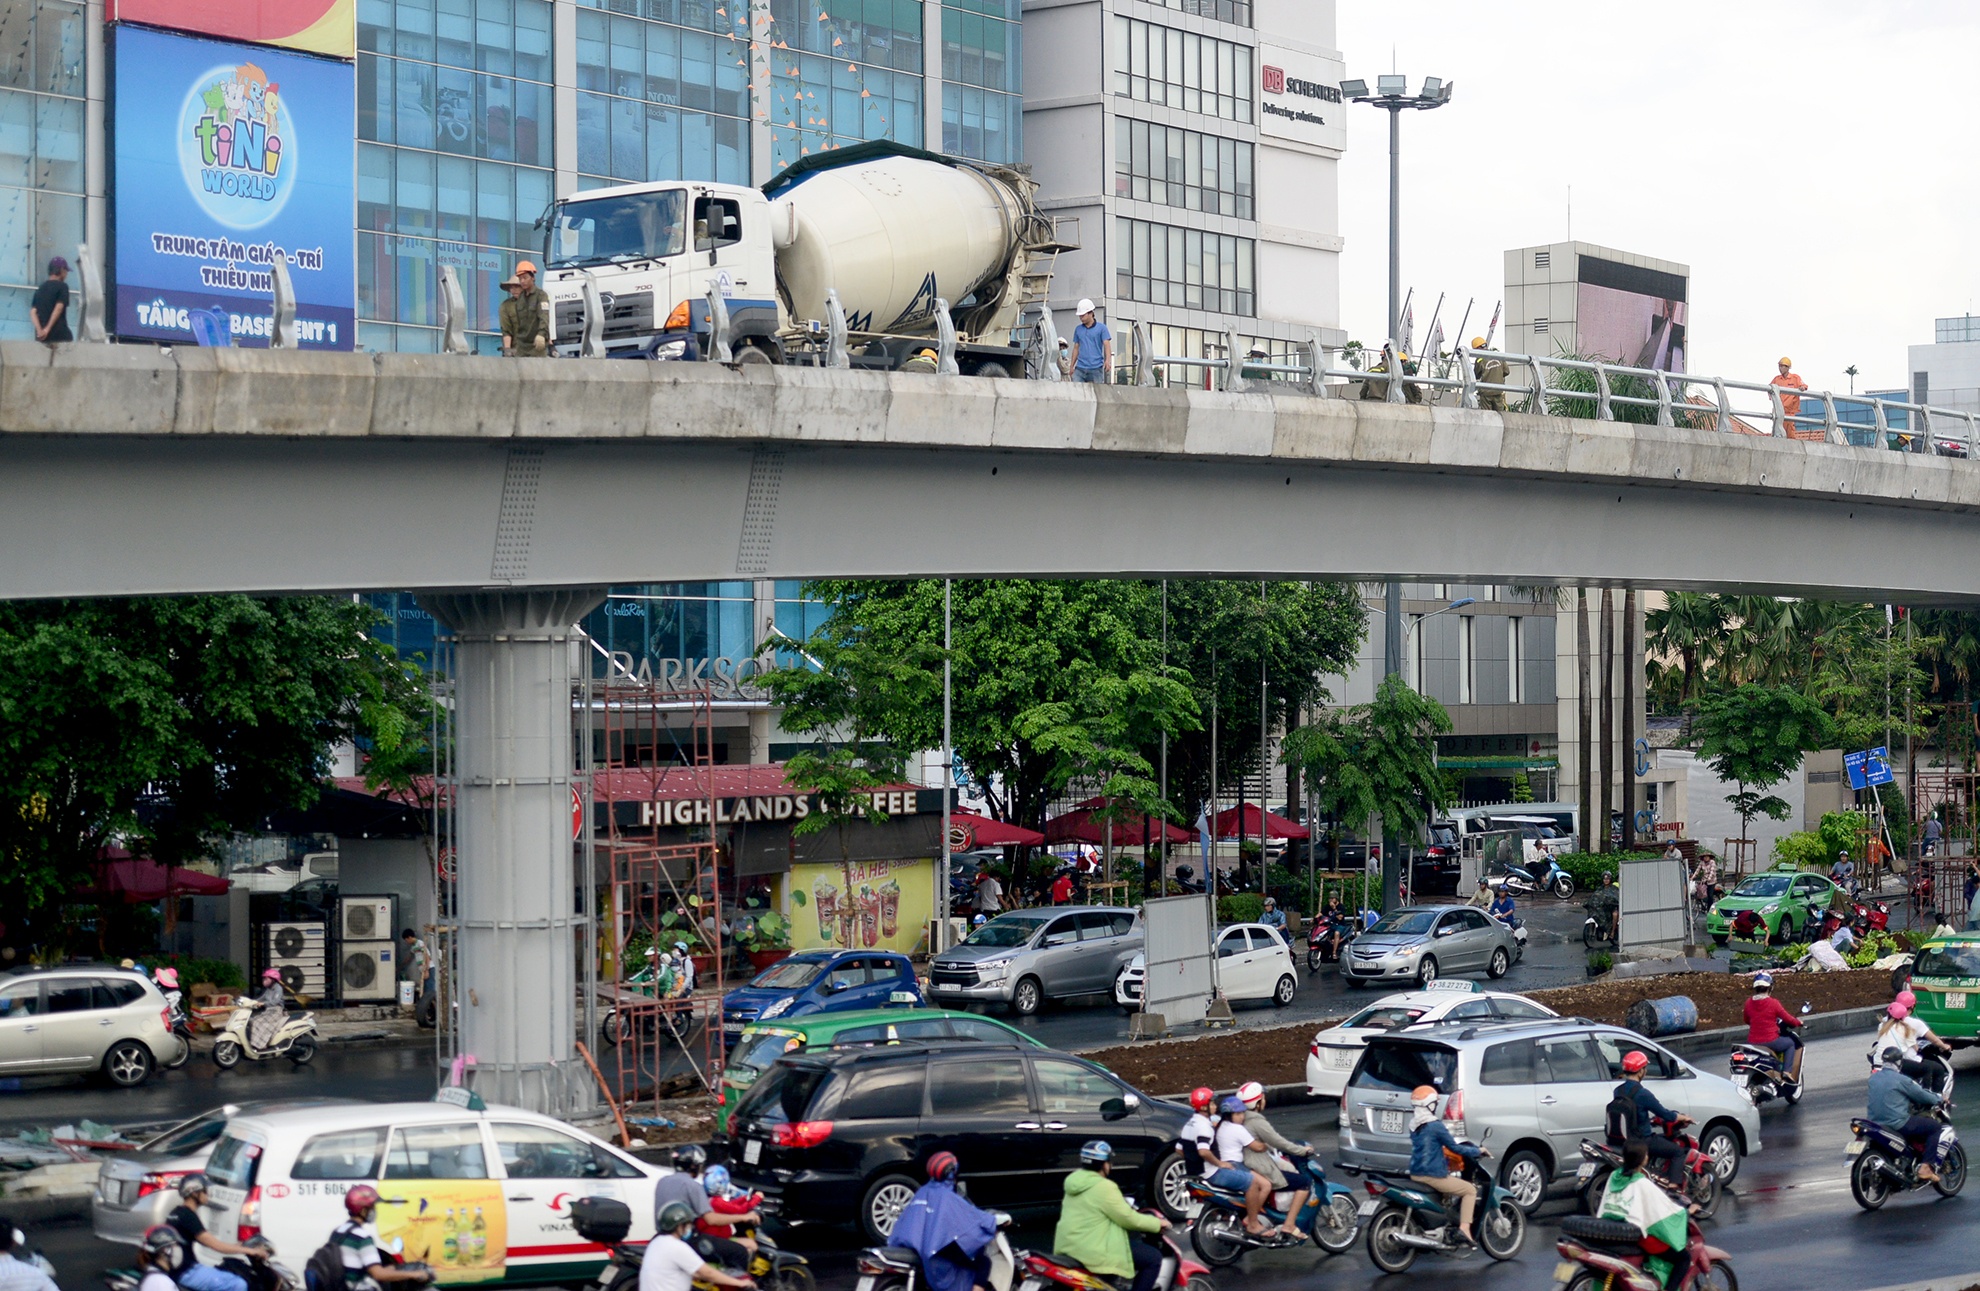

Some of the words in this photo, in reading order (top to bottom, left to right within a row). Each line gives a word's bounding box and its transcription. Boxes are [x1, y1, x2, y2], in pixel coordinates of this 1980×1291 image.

[1286, 77, 1342, 104] SCHENKER
[1263, 102, 1294, 121] Delivering
[201, 169, 276, 201] WORLD
[153, 234, 207, 259] TRUNG
[209, 237, 246, 261] TÂM
[297, 247, 323, 270] TRÍ
[202, 261, 248, 288] THIẾU
[249, 273, 275, 291] NH
[554, 292, 578, 300] HINO
[137, 299, 190, 330] TẦNG
[230, 314, 325, 342] BASEENT
[327, 323, 337, 343] 1
[642, 795, 809, 825] HIGHLANDS
[298, 1184, 317, 1195] 51F
